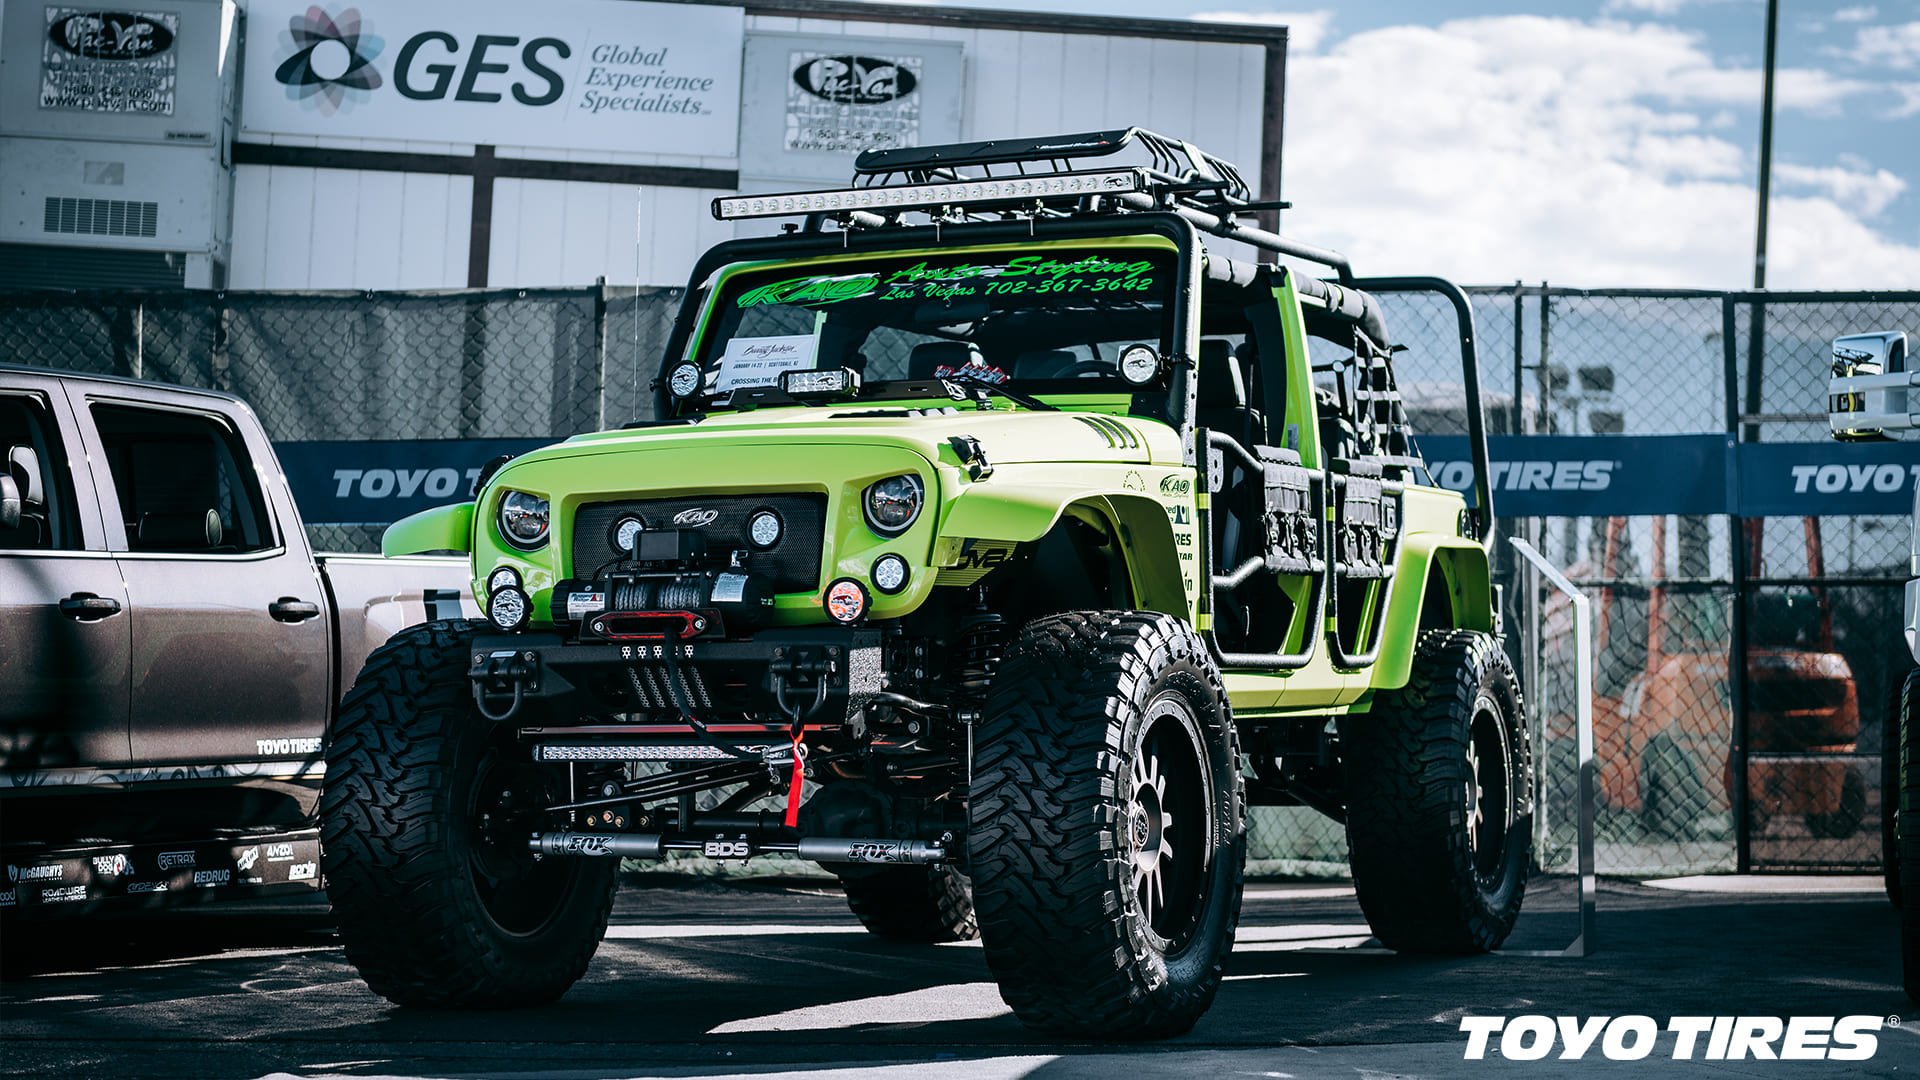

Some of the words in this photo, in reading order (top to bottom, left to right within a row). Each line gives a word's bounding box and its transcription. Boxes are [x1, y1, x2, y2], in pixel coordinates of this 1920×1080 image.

[591, 44, 668, 66] Global
[393, 31, 571, 106] GES
[585, 67, 714, 92] Experience
[580, 90, 702, 114] Specialists
[884, 262, 982, 283] Auto
[999, 255, 1156, 280] Styling
[737, 273, 879, 308] KAO
[879, 286, 915, 301] Las
[923, 283, 977, 301] Vegas
[985, 278, 1153, 297] 702-367-3642
[731, 376, 760, 385] CROSSING
[333, 468, 459, 498] TOYO
[1792, 465, 1905, 493] TOYO
[257, 739, 289, 755] TOYO
[289, 738, 322, 754] TIRES
[568, 835, 614, 856] FOX
[705, 842, 749, 857] BDS
[848, 842, 897, 862] FOX
[194, 869, 230, 883] BEDRUG
